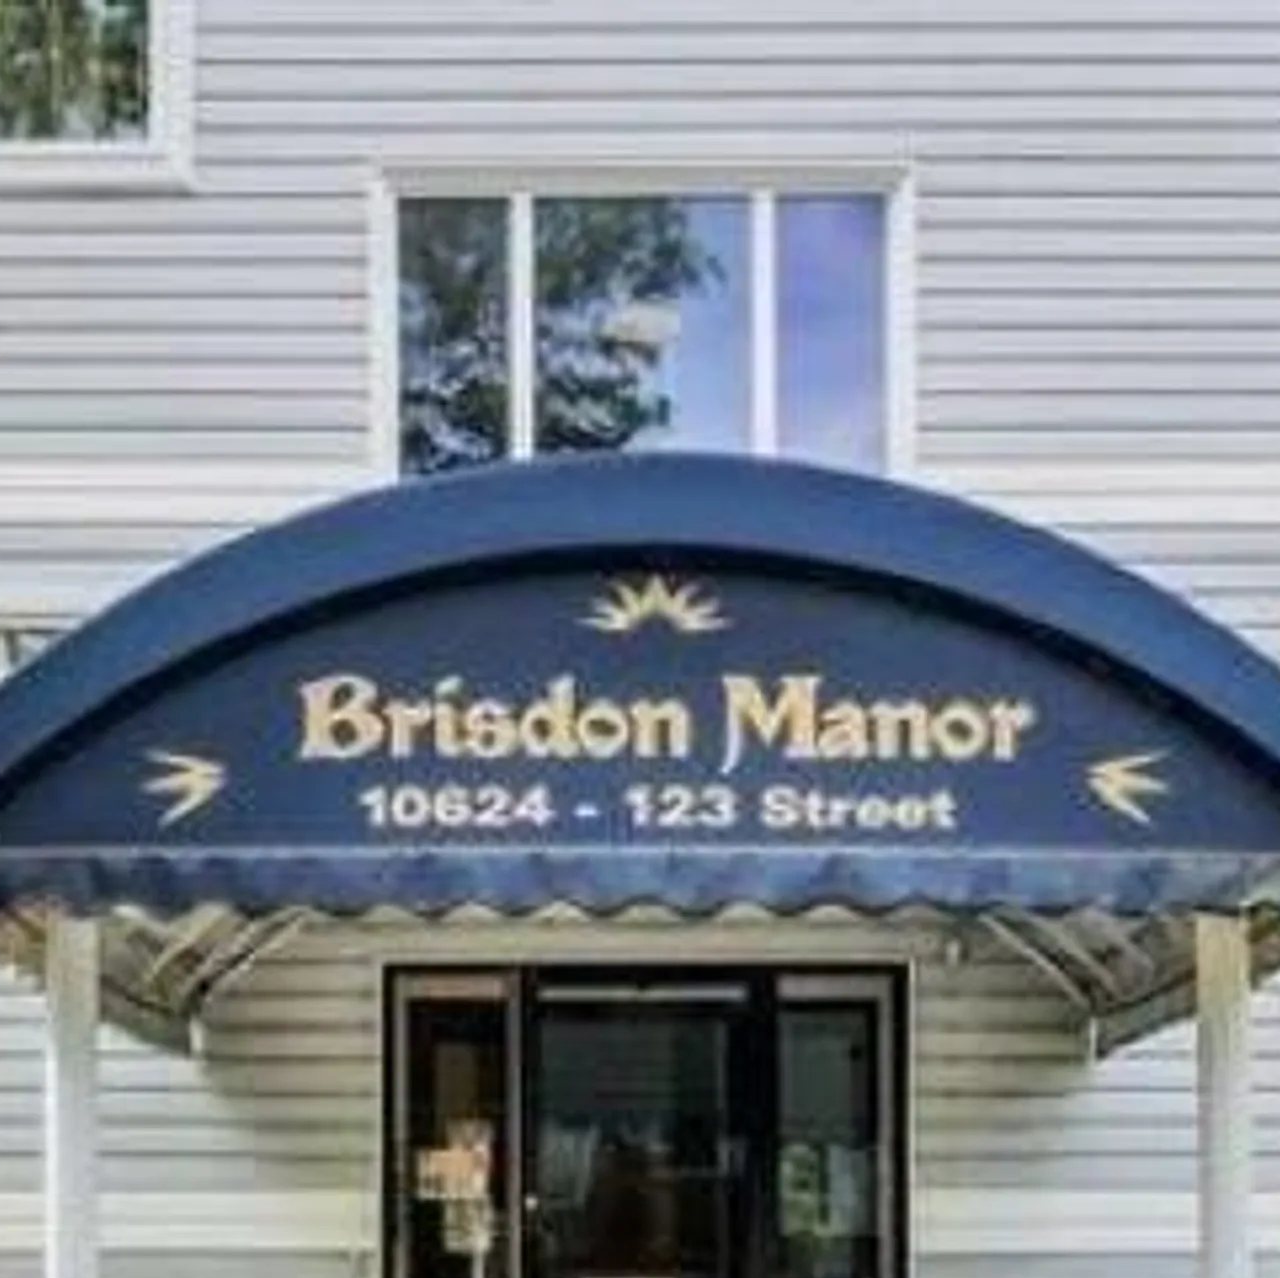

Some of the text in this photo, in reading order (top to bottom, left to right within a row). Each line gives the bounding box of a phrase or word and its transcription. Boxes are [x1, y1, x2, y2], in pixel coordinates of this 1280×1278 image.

[299, 673, 1034, 772] Brisdon Manor
[361, 785, 555, 829] 10624
[626, 785, 736, 829] 123
[763, 785, 958, 829] Street
